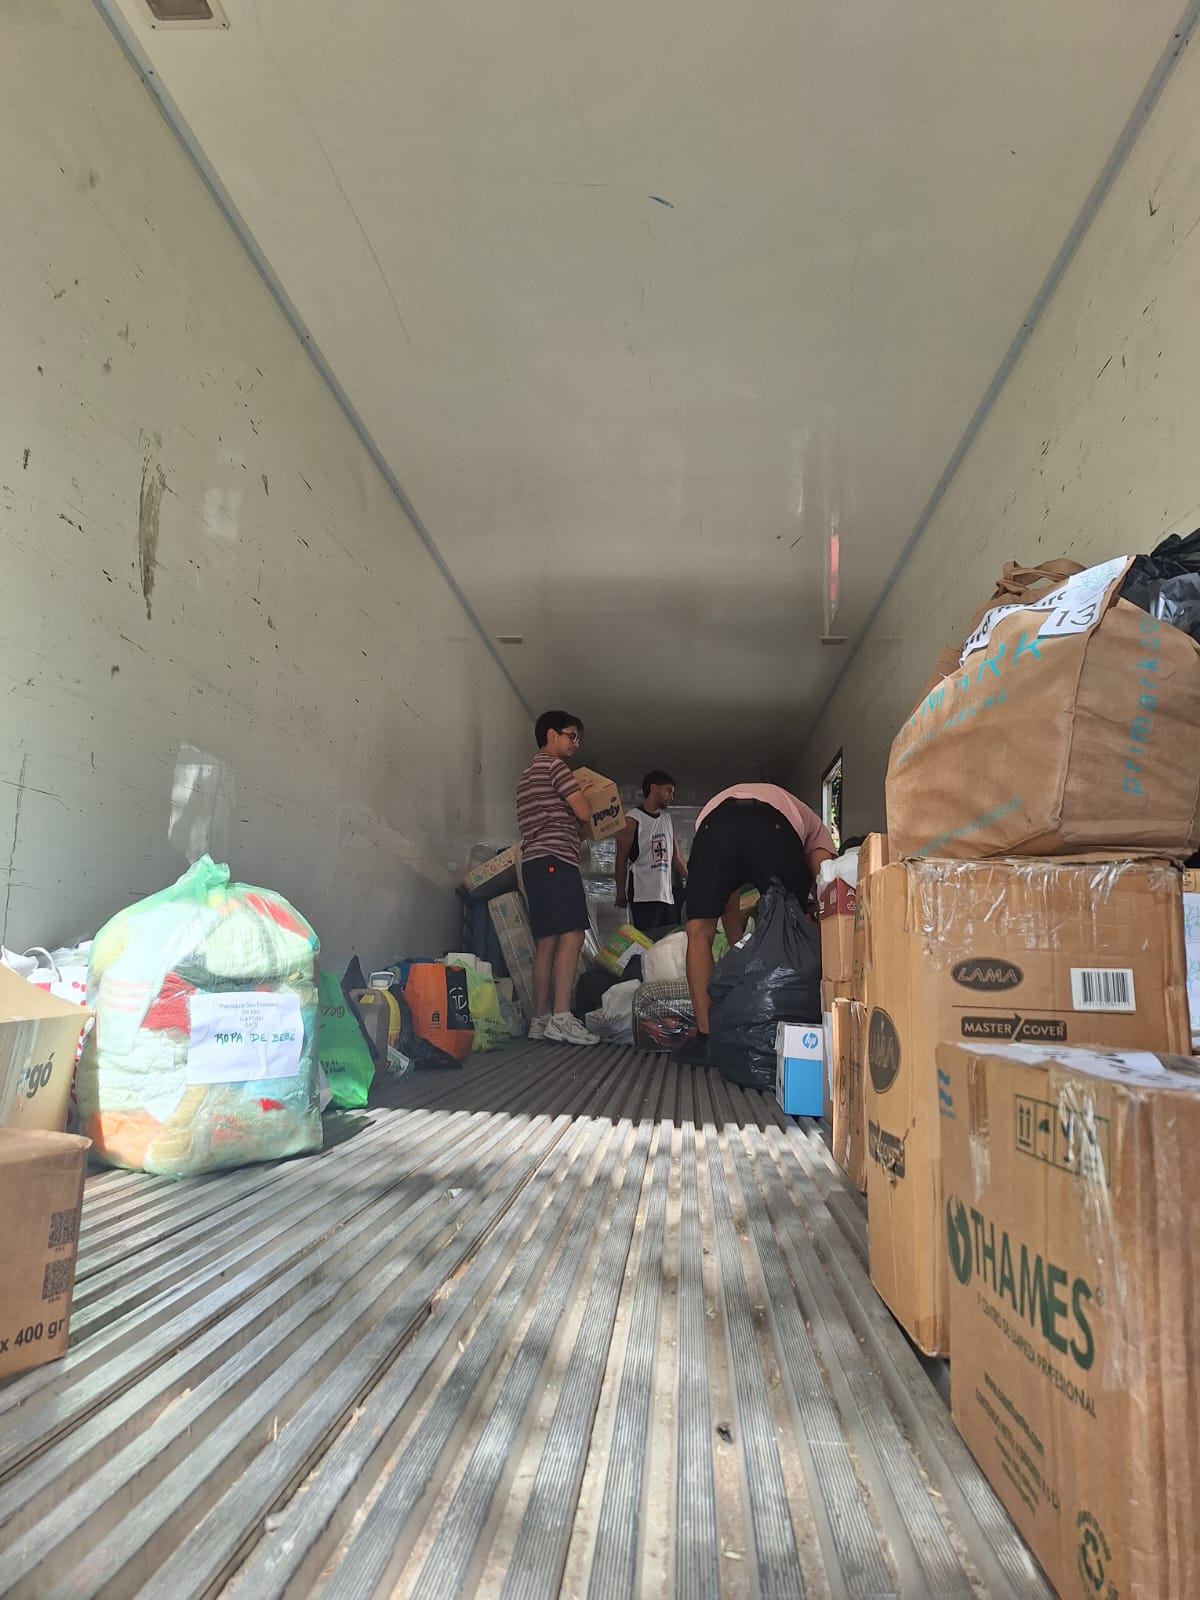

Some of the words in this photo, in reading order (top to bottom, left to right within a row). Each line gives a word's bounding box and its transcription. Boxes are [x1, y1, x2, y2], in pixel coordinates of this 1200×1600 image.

[1055, 602, 1097, 627] 13
[956, 966, 1018, 984] LAMA
[214, 1031, 243, 1045] ROPA
[249, 1032, 267, 1042] DE
[964, 1022, 1012, 1034] MASTER
[1022, 1023, 1064, 1037] COVER
[804, 1032, 818, 1049] hp
[20, 1052, 55, 1099] gó
[970, 1206, 1095, 1371] THAMES
[14, 1321, 43, 1347] 400
[47, 1318, 65, 1340] gr
